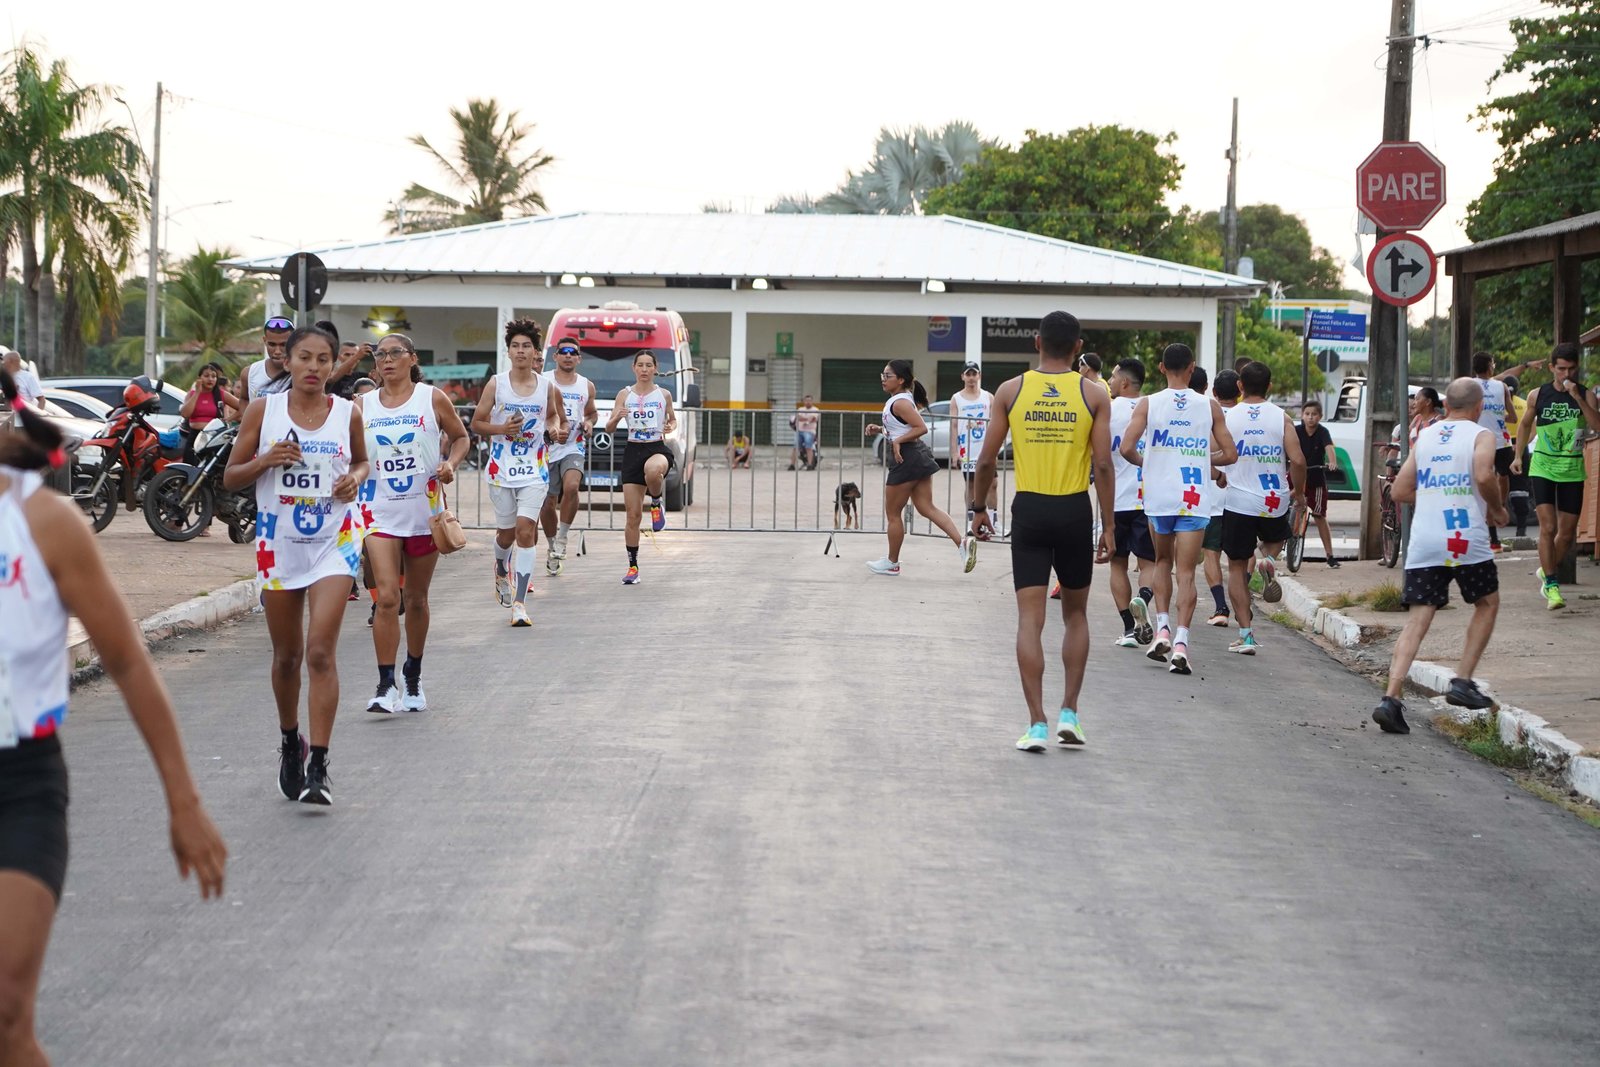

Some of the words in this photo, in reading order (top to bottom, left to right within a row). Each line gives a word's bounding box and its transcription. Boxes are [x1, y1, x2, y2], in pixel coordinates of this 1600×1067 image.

[1368, 172, 1436, 201] PARE
[986, 316, 1017, 326] C&A
[1312, 345, 1367, 353] PETROBRAS
[1024, 411, 1077, 423] ADROALDO
[1542, 409, 1580, 420] DREAM
[368, 419, 401, 428] AUTISMO
[320, 446, 339, 454] RUN
[384, 457, 417, 472] 052
[508, 466, 534, 476] 042
[282, 473, 320, 488] 061
[303, 502, 332, 515] Azul
